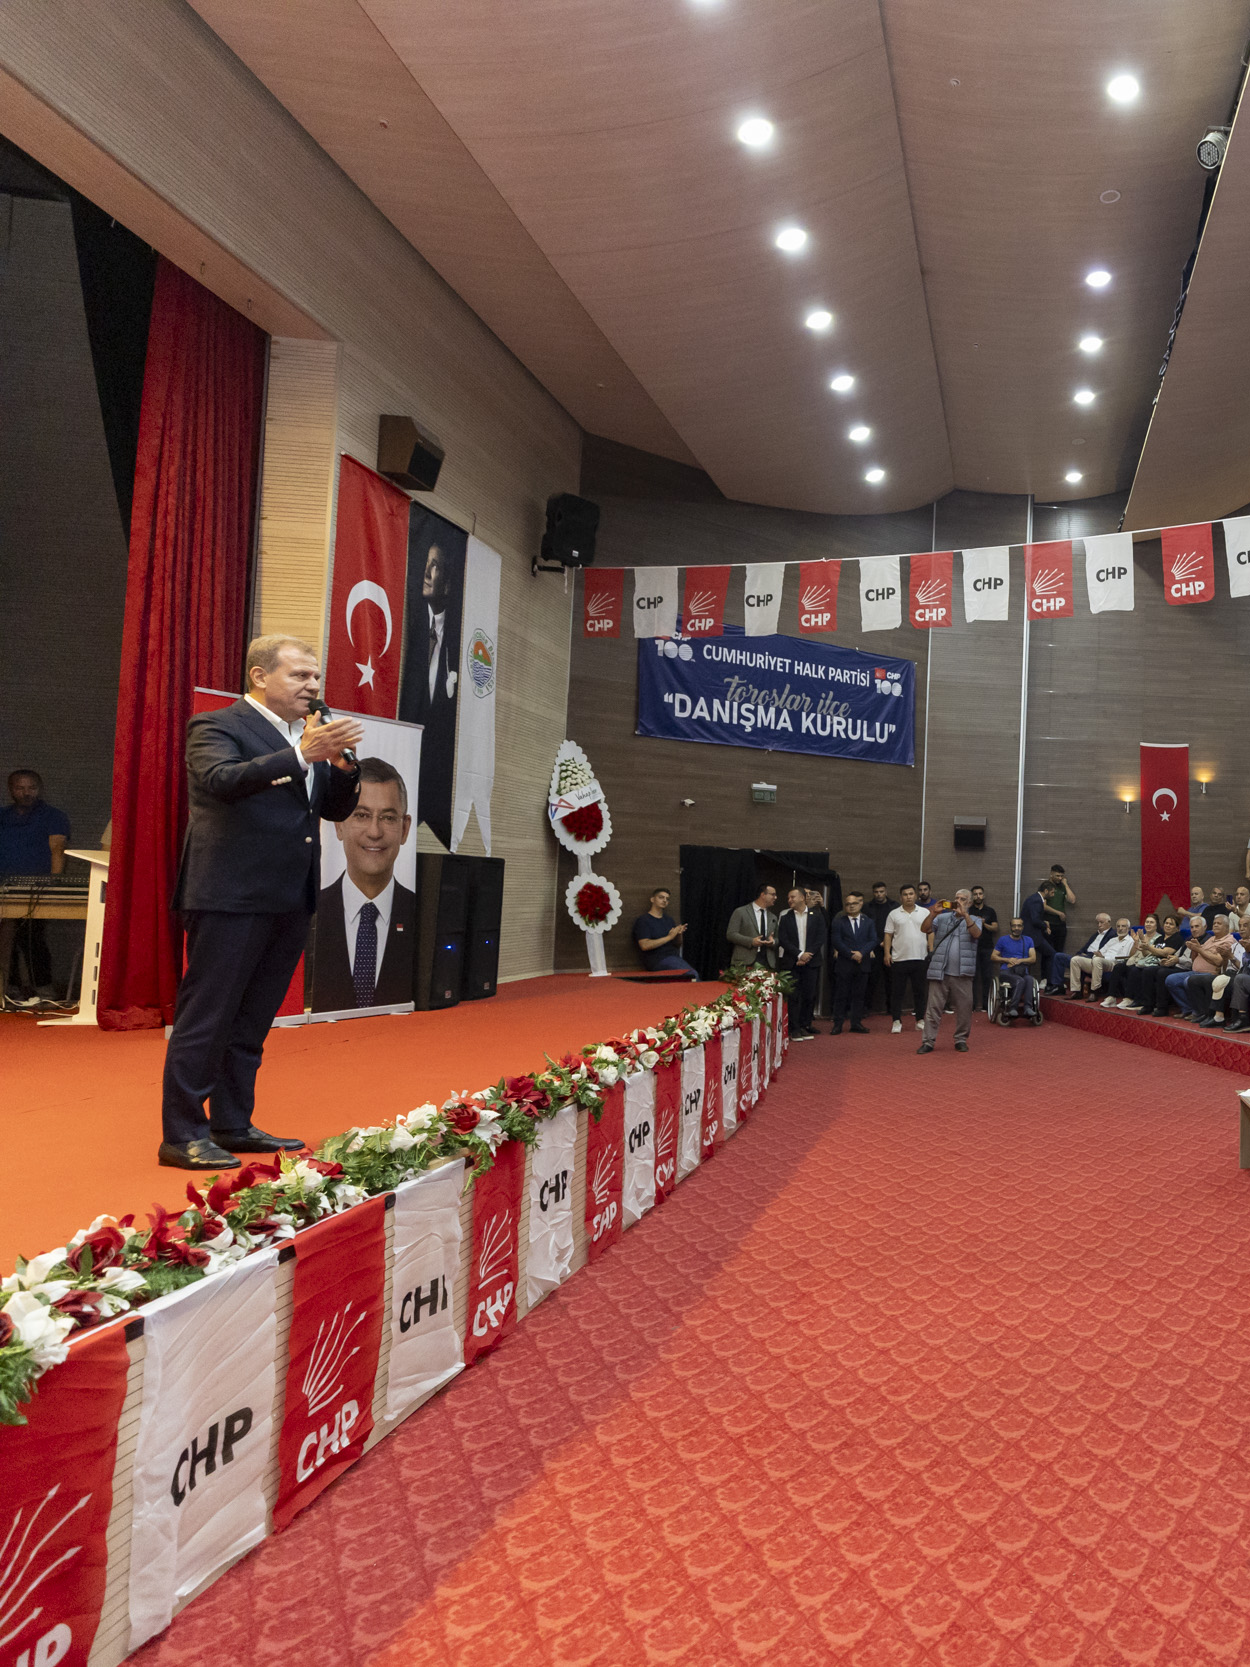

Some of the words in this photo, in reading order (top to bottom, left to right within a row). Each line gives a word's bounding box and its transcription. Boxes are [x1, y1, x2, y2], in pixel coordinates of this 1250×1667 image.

[1095, 566, 1128, 583] CHP
[972, 576, 1004, 592] CHP
[1170, 581, 1205, 598] CHP
[636, 595, 664, 610] CHP
[745, 594, 773, 607] CHP
[865, 587, 896, 602] CHP
[1031, 597, 1066, 613] CHP
[800, 612, 831, 627] CHP
[915, 607, 947, 622] CHP
[586, 619, 614, 632] CHP
[687, 618, 714, 632] CHP
[703, 644, 792, 673] CUMHURİYET
[794, 661, 825, 679] HALK
[829, 667, 870, 687] PARTİSİ
[886, 671, 901, 680] CHP
[724, 675, 813, 712] toroslar
[629, 1121, 650, 1153] CHP
[539, 1170, 567, 1212] CHP
[472, 1281, 513, 1337] CHP
[296, 1399, 359, 1483] CHP
[171, 1407, 253, 1507] CHP
